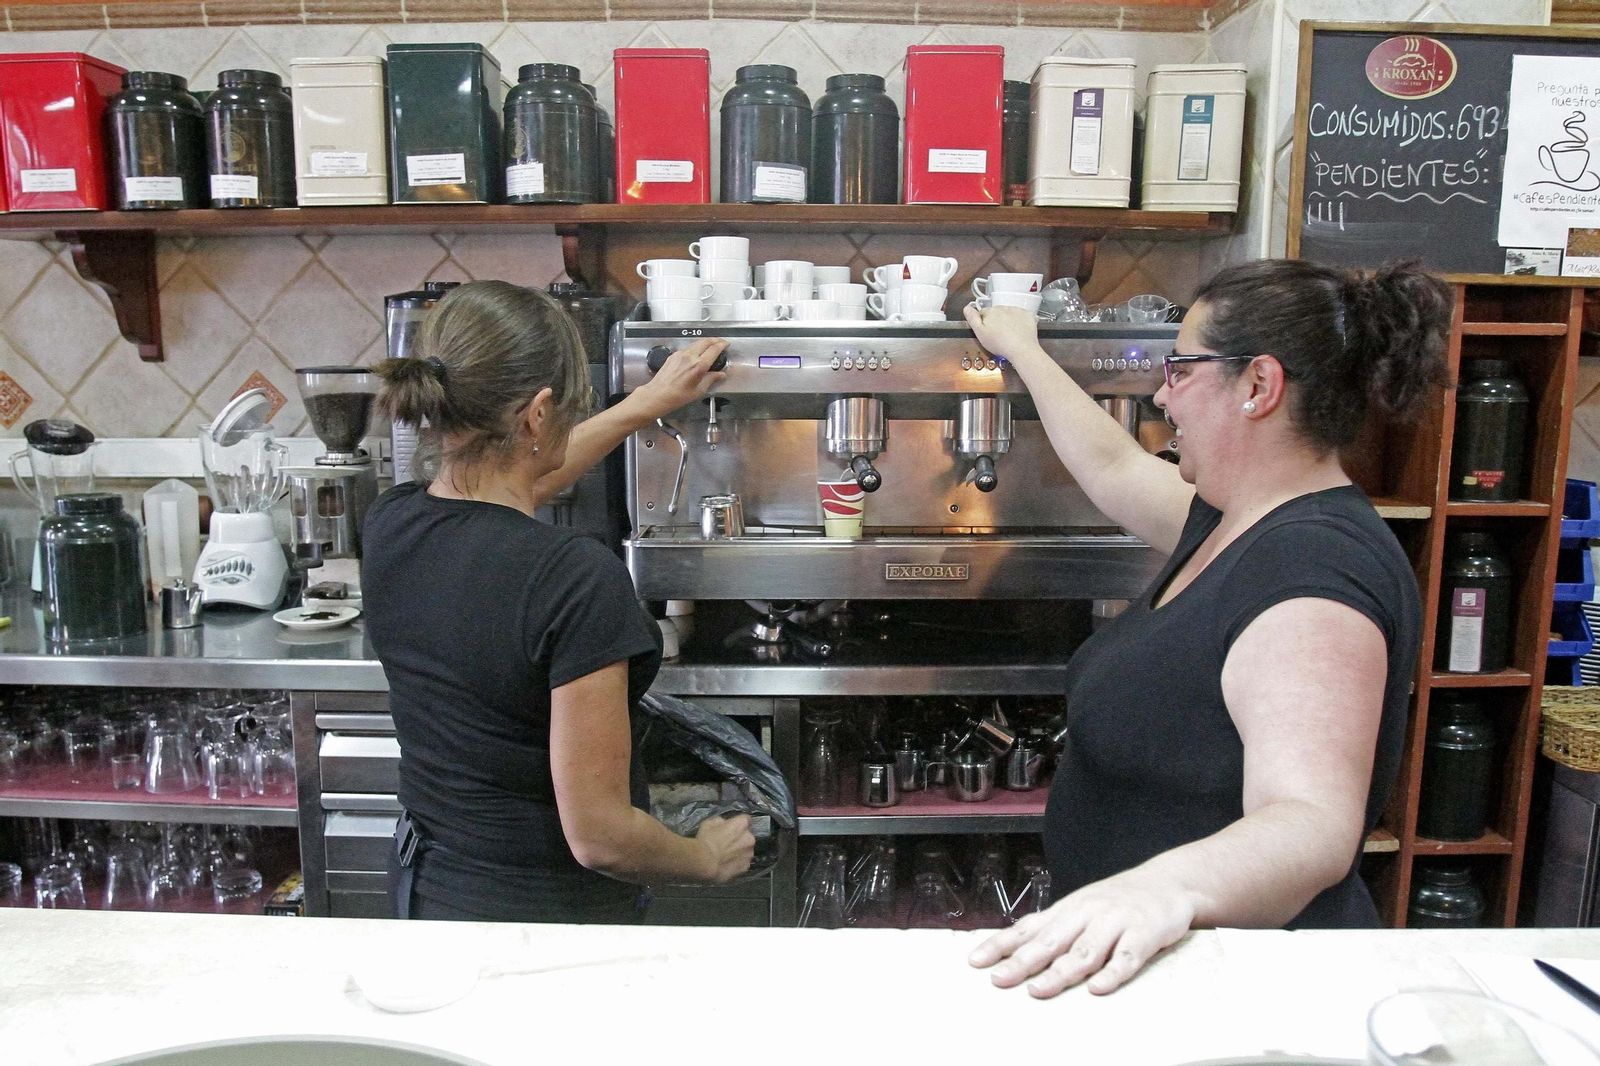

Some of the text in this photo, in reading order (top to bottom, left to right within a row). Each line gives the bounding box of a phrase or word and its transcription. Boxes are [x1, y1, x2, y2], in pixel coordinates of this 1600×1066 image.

[1383, 67, 1436, 80] KROXAN
[1537, 81, 1589, 96] Pregunta
[888, 566, 966, 578] EXPOBAR
